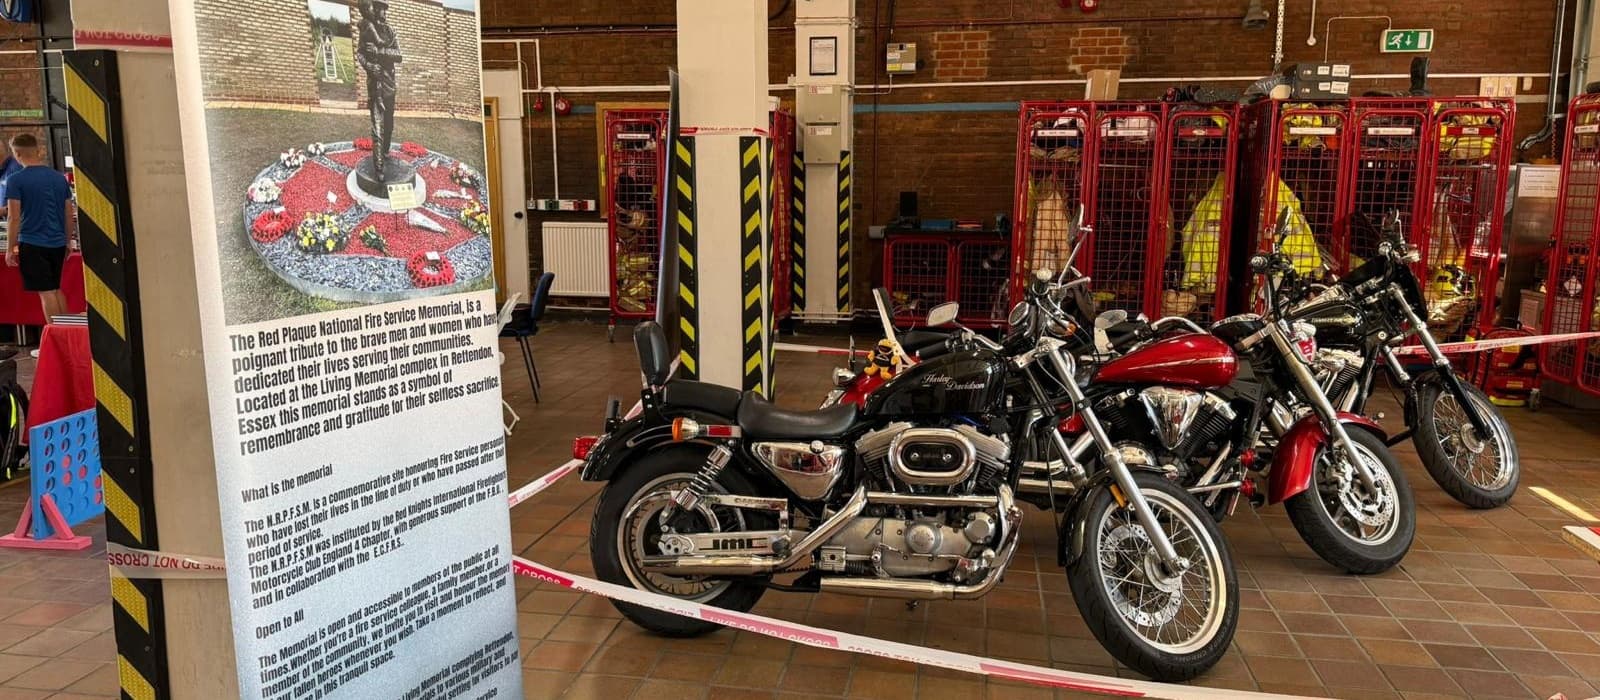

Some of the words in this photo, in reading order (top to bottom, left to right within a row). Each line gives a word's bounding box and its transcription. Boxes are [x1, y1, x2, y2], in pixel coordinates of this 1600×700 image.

[230, 332, 255, 352] The
[258, 328, 279, 347] Red
[281, 322, 317, 346] Plaque
[319, 315, 362, 337] National
[364, 312, 382, 329] Fire
[383, 307, 416, 326] Service
[418, 300, 464, 321] Memorial,
[466, 298, 474, 312] is
[475, 300, 480, 311] a
[232, 348, 287, 375] poignant
[289, 341, 324, 361] tribute
[327, 339, 338, 354] to
[340, 336, 357, 352] the
[360, 331, 387, 348] brave
[388, 329, 407, 343] men
[409, 324, 426, 339] and
[429, 320, 462, 335] women
[464, 314, 481, 328] who
[234, 366, 295, 393] dedicated
[297, 361, 320, 380] their
[323, 355, 349, 374] lives
[352, 348, 388, 371] serving
[390, 343, 409, 361] their
[412, 331, 473, 356] communities.
[236, 388, 286, 414] Located
[288, 385, 299, 402] at
[301, 381, 318, 399] the
[320, 374, 352, 397] Living
[354, 364, 398, 387] Memorial
[399, 356, 437, 379] complex
[439, 353, 448, 367] in
[451, 344, 493, 366] Rettendon,
[921, 373, 953, 384] Harley
[944, 380, 985, 391] Davidson
[238, 412, 276, 435] Essex
[279, 406, 299, 425] this
[301, 394, 351, 419] memorial
[353, 385, 386, 406] stands
[388, 384, 398, 397] as
[400, 383, 406, 394] a
[407, 372, 441, 394] symbol
[443, 369, 452, 383] of
[240, 421, 320, 456] remembrance
[322, 415, 342, 433] and
[345, 403, 390, 429] gratitude
[391, 399, 403, 414] for
[405, 393, 425, 411] their
[428, 383, 464, 404] selfless
[241, 483, 268, 504] What
[270, 480, 279, 494] is
[280, 475, 295, 491] the
[296, 463, 332, 486] memorial
[244, 515, 264, 534] The
[312, 496, 320, 510] is
[321, 496, 327, 507] a
[328, 472, 390, 504] commemorative
[391, 468, 404, 481] site
[405, 456, 438, 479] honouring
[439, 452, 452, 465] Fire
[454, 443, 478, 460] Service
[246, 530, 269, 550] who
[271, 522, 292, 541] have
[294, 516, 309, 532] lost
[310, 509, 327, 526] their
[330, 501, 349, 519] lives
[351, 498, 358, 511] in
[360, 493, 373, 507] the
[375, 487, 388, 502] line
[390, 484, 396, 496] of
[397, 479, 411, 495] duty
[421, 471, 435, 485] who
[437, 464, 453, 479] have
[455, 456, 479, 474] passed
[480, 451, 493, 464] after
[108, 552, 149, 567] CROSS
[248, 541, 281, 567] period
[282, 537, 291, 552] of
[292, 525, 323, 547] service.
[249, 561, 268, 580] The
[315, 539, 330, 554] was
[332, 522, 370, 547] instituted
[371, 517, 381, 533] by
[382, 512, 394, 526] the
[407, 498, 432, 518] Knights
[433, 481, 475, 507] International
[251, 562, 303, 597] Motorcycle
[304, 555, 321, 572] Club
[322, 542, 352, 566] England
[354, 539, 359, 551] 4
[408, 510, 439, 530] generous
[440, 497, 466, 518] support
[153, 555, 178, 568] NOT
[252, 590, 272, 609] and
[274, 585, 284, 600] in
[285, 563, 336, 596] collaboration
[337, 555, 355, 573] with
[356, 549, 369, 565] the
[255, 618, 281, 642] Open
[282, 613, 292, 628] to
[293, 608, 304, 623] All
[259, 649, 277, 670] The
[279, 630, 317, 660] Memorial
[318, 625, 326, 640] is
[327, 618, 346, 637] open
[347, 608, 362, 625] and
[363, 589, 403, 617] accessible
[404, 585, 410, 597] to
[411, 570, 441, 593] members
[442, 566, 449, 578] of
[451, 560, 462, 574] the
[463, 551, 482, 570] public
[484, 547, 490, 558] at
[261, 669, 299, 699] member
[302, 663, 310, 678] of
[311, 657, 323, 673] the
[371, 628, 382, 641] we
[384, 616, 403, 634] invite
[405, 611, 415, 625] you
[417, 606, 423, 617] to
[424, 598, 438, 613] visit
[440, 591, 452, 606] and
[454, 579, 475, 598] honour
[348, 629, 353, 639] a
[355, 619, 368, 636] fire
[370, 605, 397, 628] service
[293, 675, 316, 697] fallen
[317, 661, 342, 685] heroes
[344, 640, 381, 670] whenever
[383, 634, 397, 650] you
[415, 615, 430, 631] Take
[430, 614, 435, 623] a
[436, 597, 464, 620] moment
[323, 677, 337, 695] this
[338, 660, 369, 689] tranquil
[370, 648, 395, 671] space.
